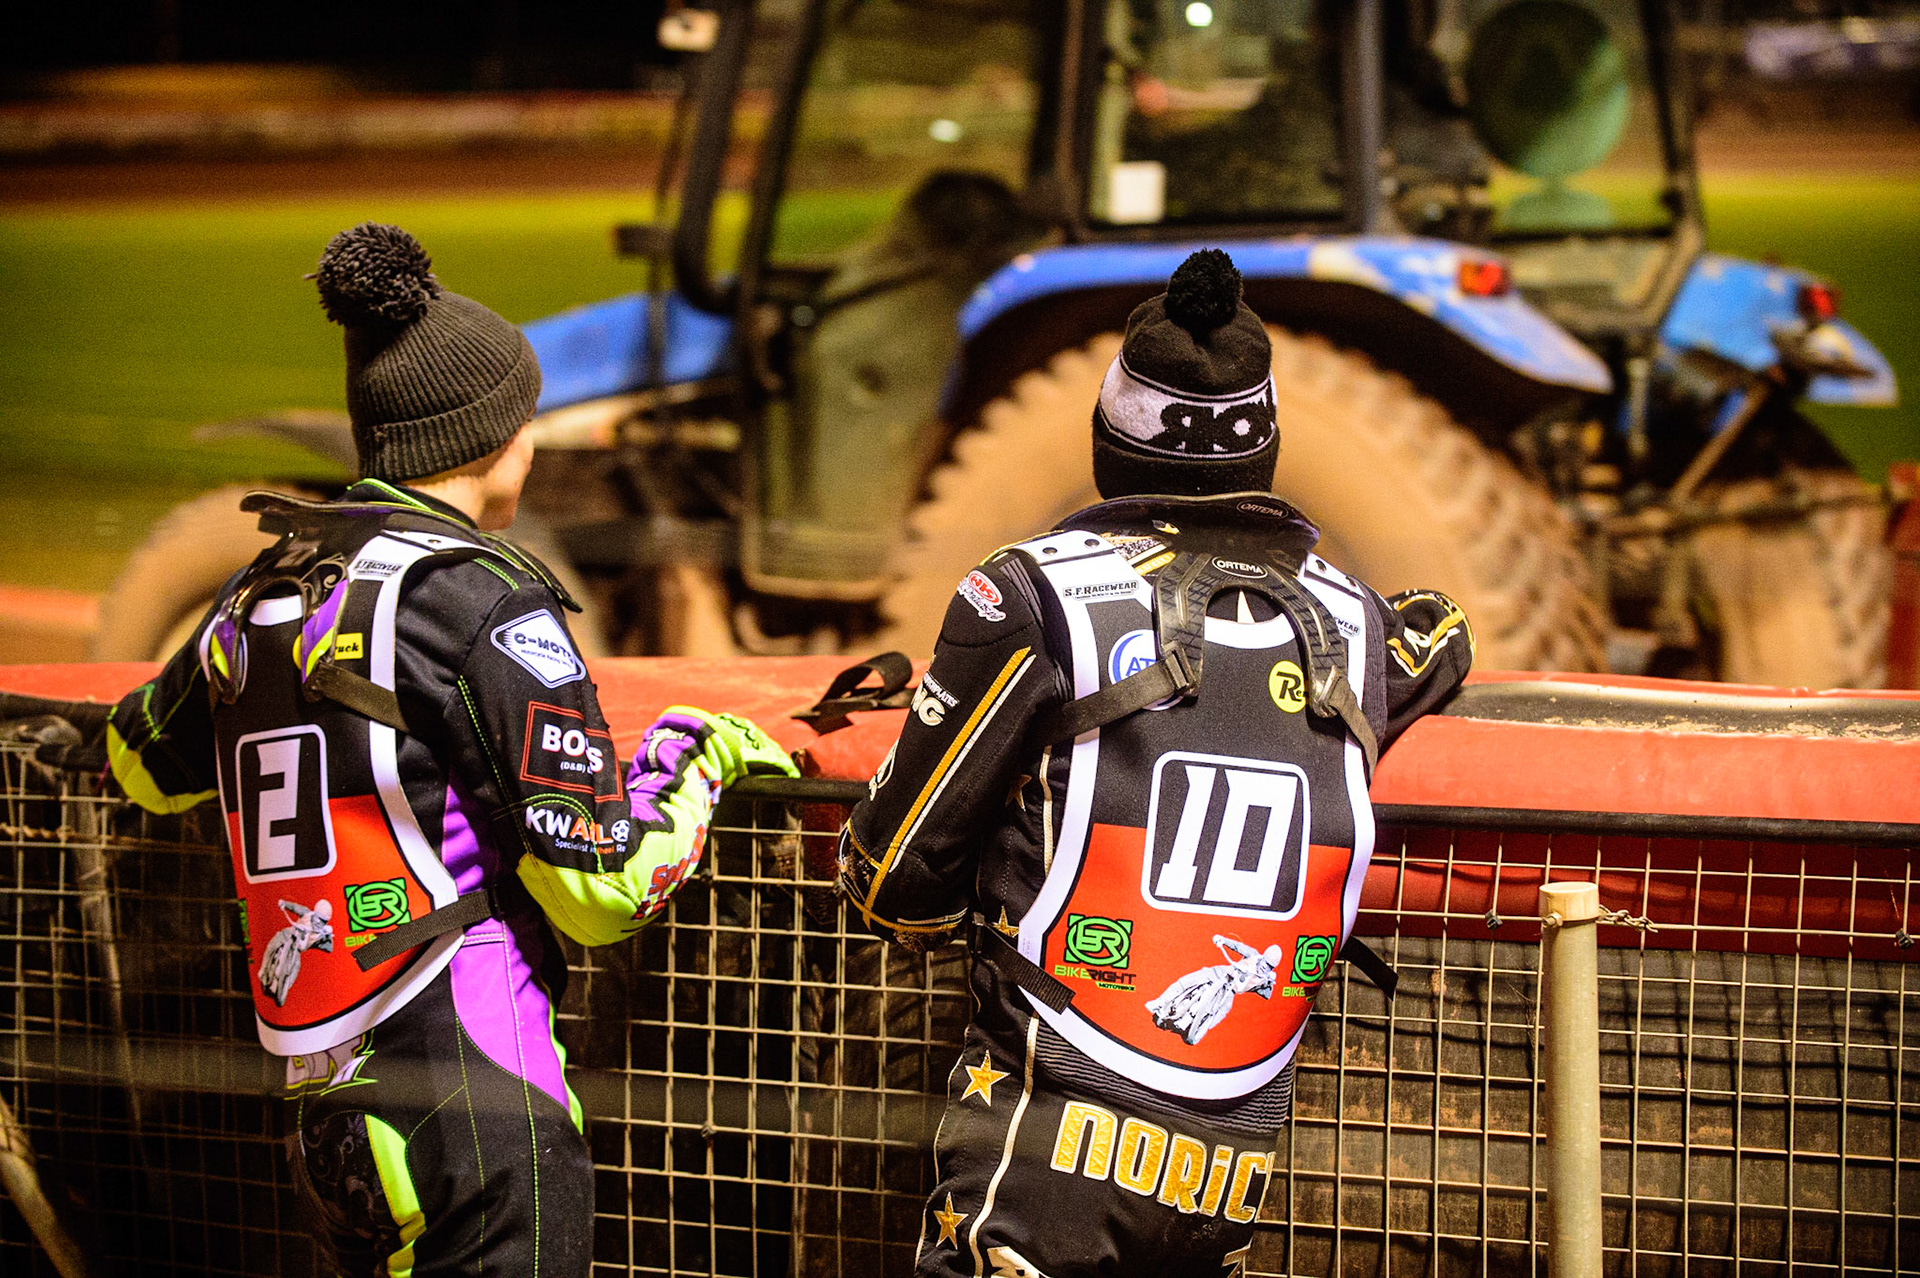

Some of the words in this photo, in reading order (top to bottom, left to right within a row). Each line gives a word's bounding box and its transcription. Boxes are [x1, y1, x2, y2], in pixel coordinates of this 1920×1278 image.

[1240, 503, 1284, 517] ORTEMA
[1216, 560, 1264, 575] ORTEMA
[542, 723, 604, 773] BOS
[560, 761, 586, 773] (D&B)
[256, 738, 301, 871] 2
[1154, 764, 1298, 907] 10
[555, 838, 589, 853] Specialist
